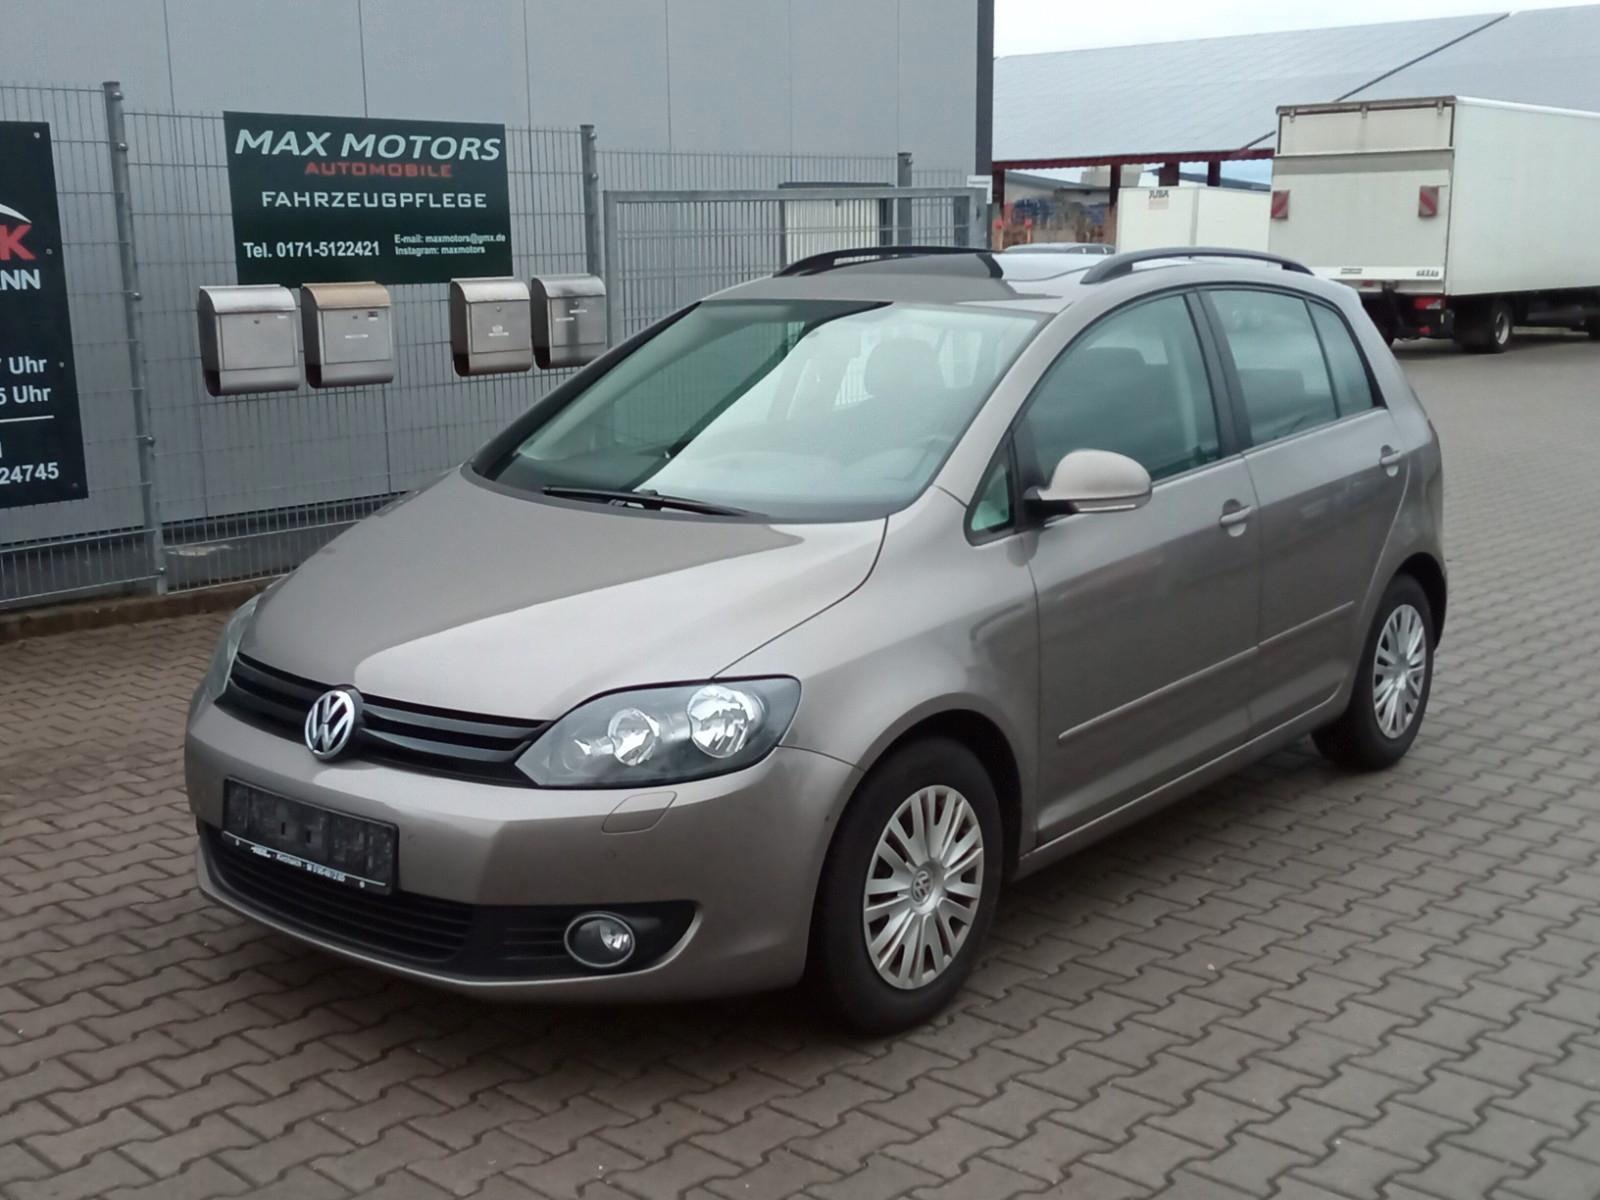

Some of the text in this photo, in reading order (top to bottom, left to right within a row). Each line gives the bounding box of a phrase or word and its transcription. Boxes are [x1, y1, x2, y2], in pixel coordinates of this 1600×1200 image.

[235, 129, 501, 160] MAX MOTORS
[304, 161, 453, 177] AUTOMOBILE
[261, 191, 487, 208] FAHRZEUGPFLEGE
[393, 233, 506, 245] E-mail: maxmotors@gmx.de
[242, 240, 380, 258] Tel. 0171-5122421
[395, 245, 486, 257] Instagram: maxmotors
[0, 269, 41, 290] NN
[9, 356, 47, 374] Uhr
[13, 385, 51, 404] Uhr
[0, 462, 59, 484] 24745
